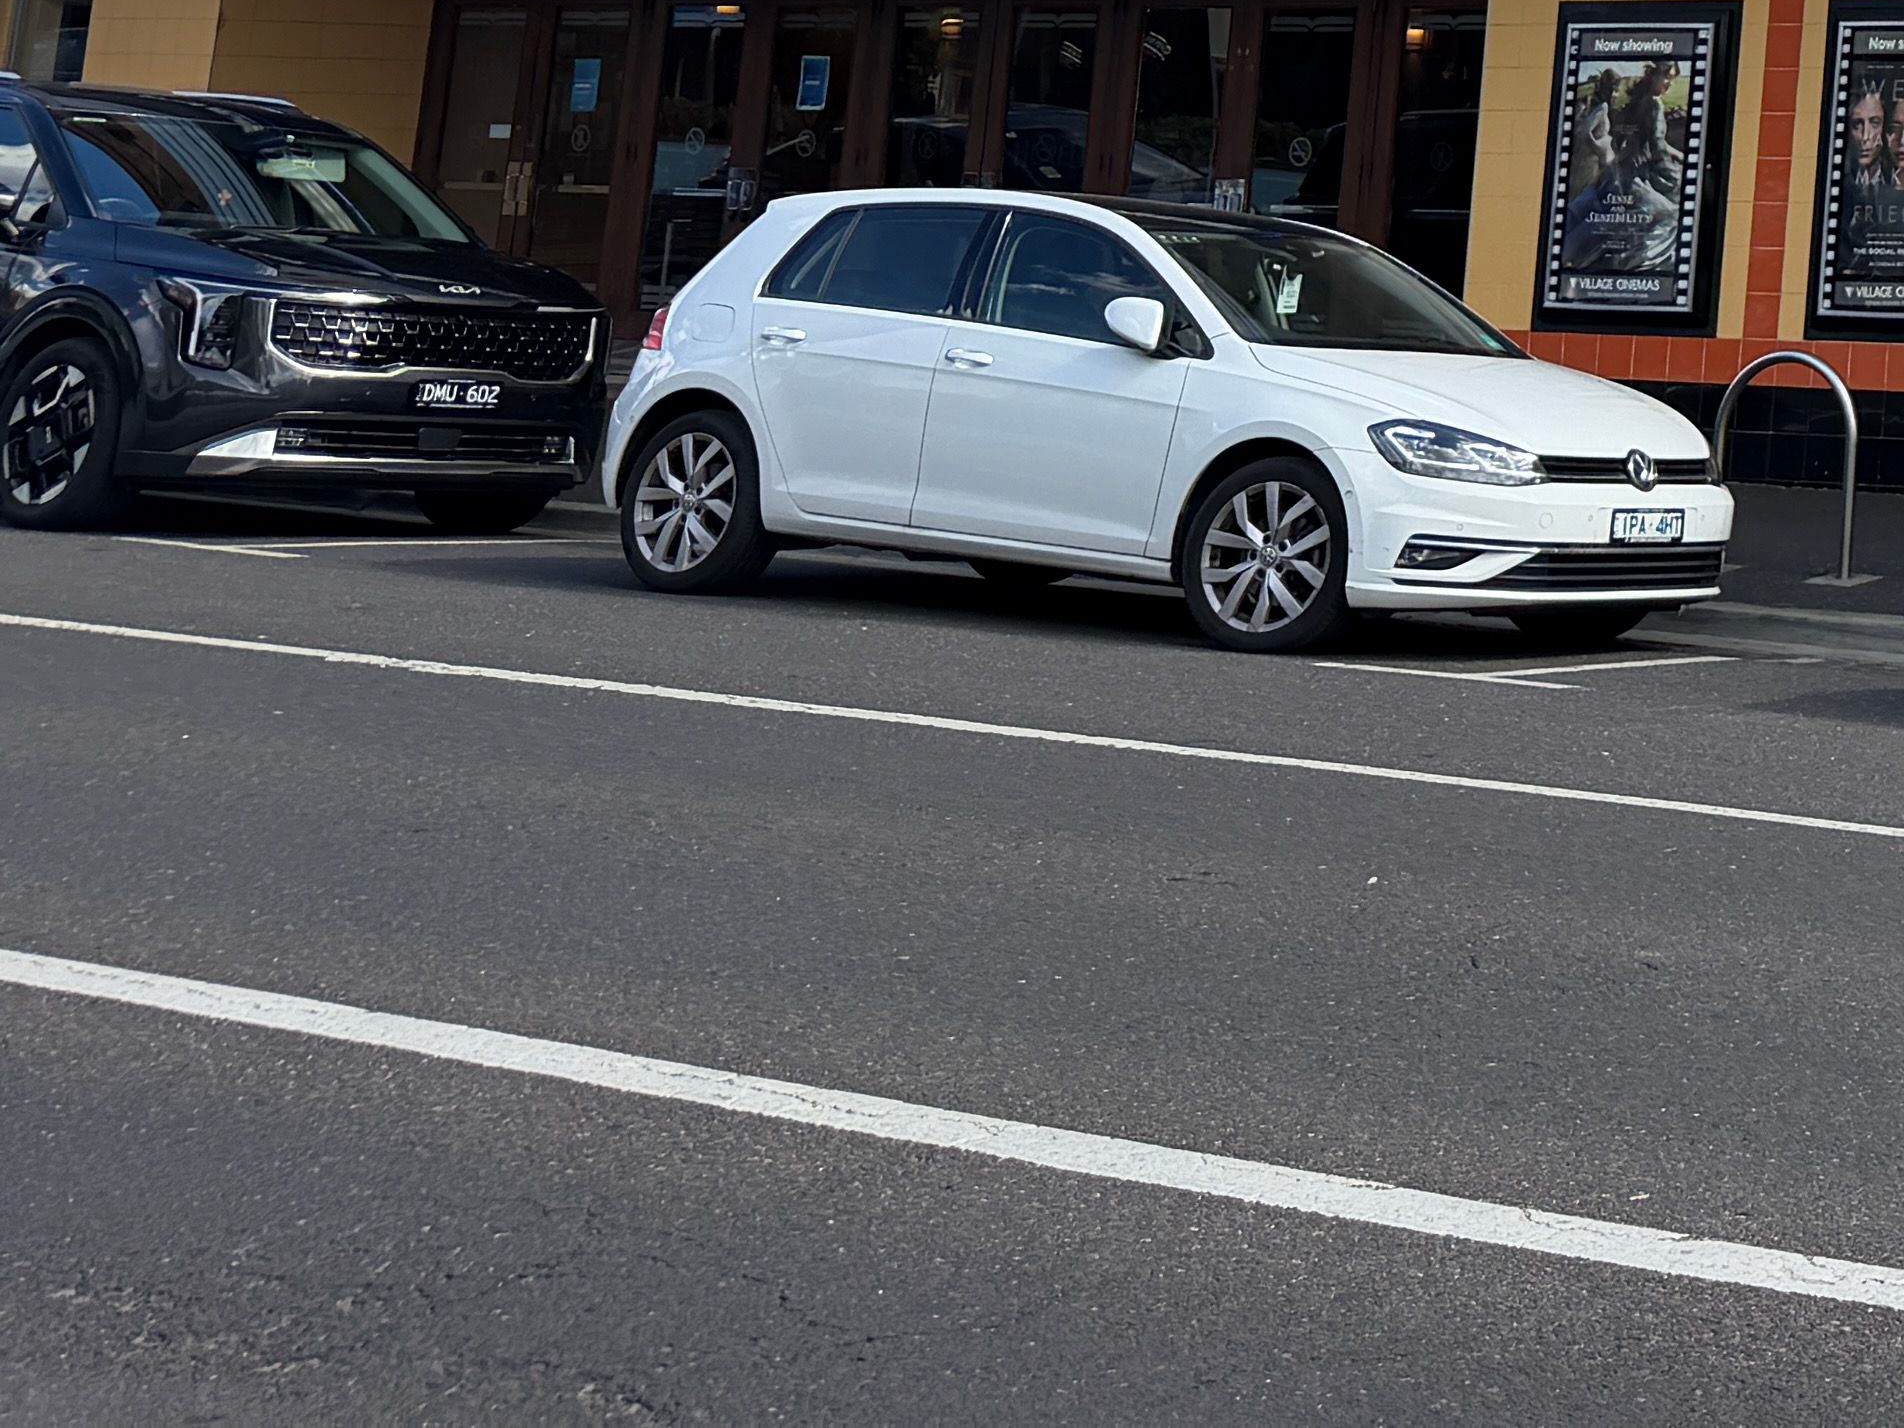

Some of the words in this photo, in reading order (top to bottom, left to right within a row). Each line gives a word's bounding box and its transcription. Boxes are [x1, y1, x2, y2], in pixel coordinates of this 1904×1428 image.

[1594, 38, 1621, 51] Now
[1622, 37, 1673, 54] showing
[1868, 36, 1896, 50] Now
[1602, 192, 1634, 205] SENSE
[1585, 211, 1654, 223] SENSIBILITY
[1579, 277, 1614, 290] VILLAGE
[1616, 278, 1660, 291] CINEMAS
[1856, 285, 1893, 298] VILLAGE
